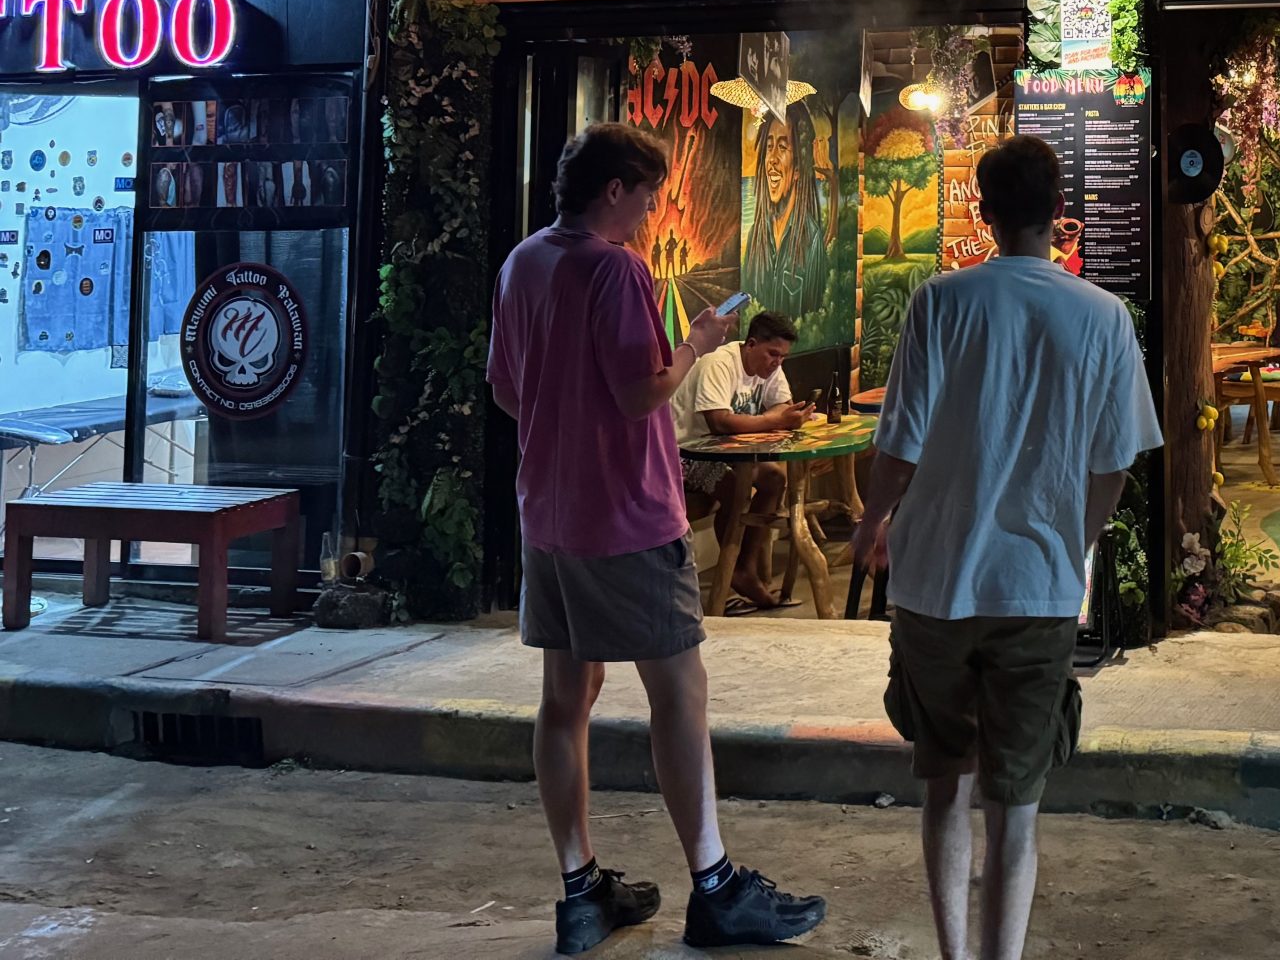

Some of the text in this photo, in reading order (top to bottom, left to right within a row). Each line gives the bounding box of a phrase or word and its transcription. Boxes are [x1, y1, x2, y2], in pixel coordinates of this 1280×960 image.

[1023, 77, 1104, 95] FOOD MENU
[966, 106, 1015, 140] PINK
[95, 230, 112, 240] MO
[946, 236, 990, 259] THE
[185, 264, 303, 350] Mayumi Tattoo Palawan
[188, 359, 221, 402] CONTACT
